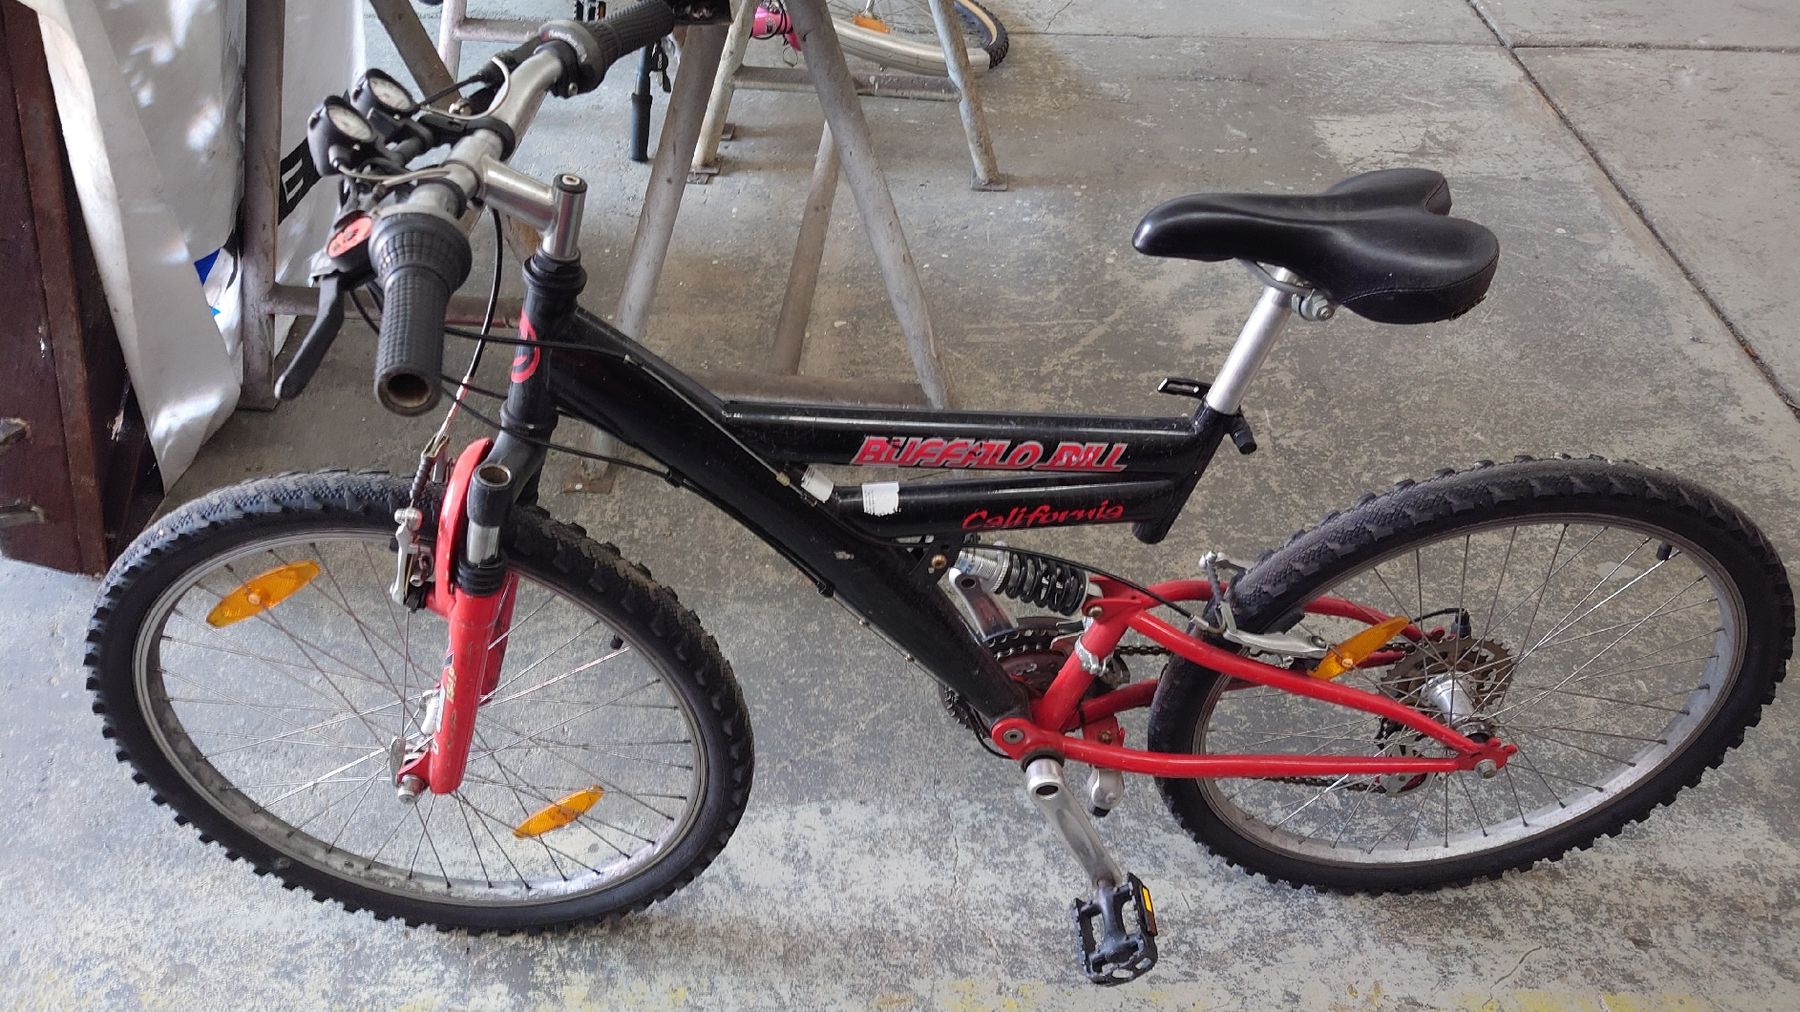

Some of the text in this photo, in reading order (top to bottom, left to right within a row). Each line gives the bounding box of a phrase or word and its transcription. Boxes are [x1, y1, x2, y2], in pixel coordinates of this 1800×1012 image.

[850, 436, 1128, 472] BUFFALO BILL
[961, 500, 1124, 529] California
